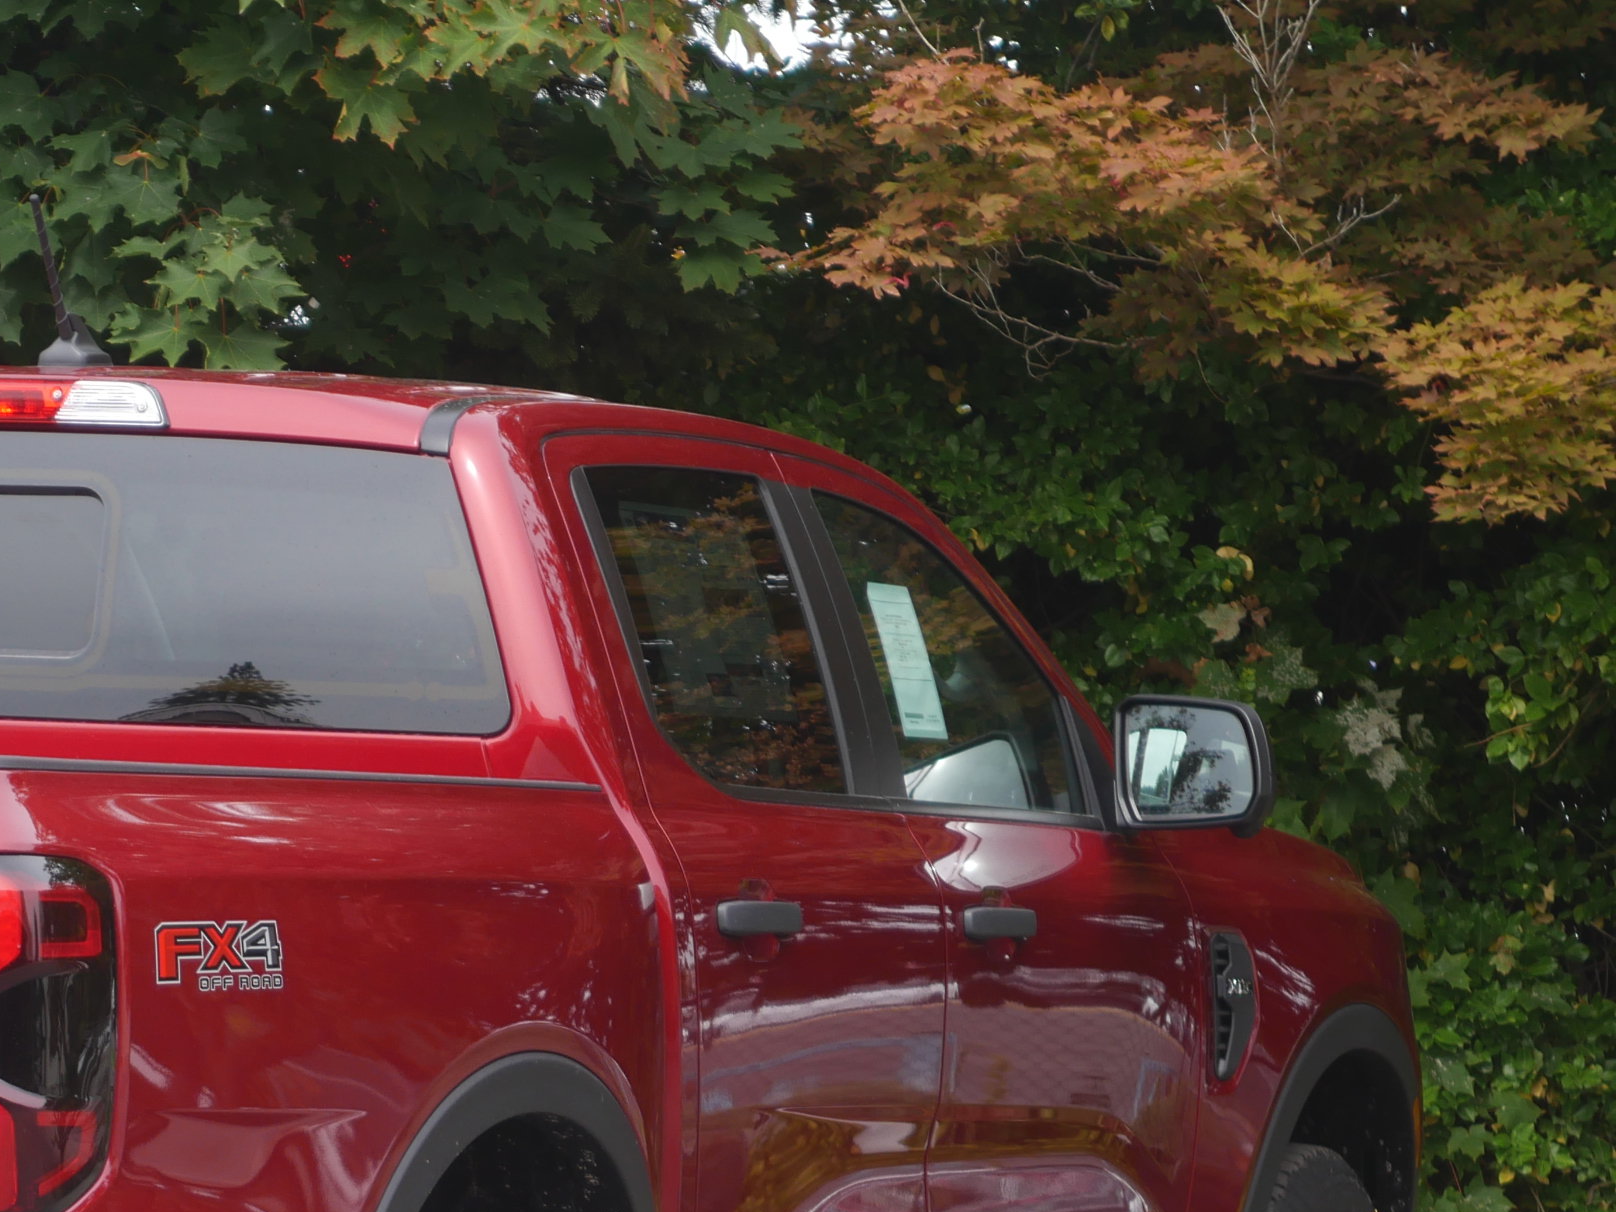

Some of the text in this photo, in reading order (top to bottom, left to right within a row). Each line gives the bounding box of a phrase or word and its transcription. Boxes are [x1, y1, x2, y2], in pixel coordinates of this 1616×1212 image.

[154, 919, 282, 984] FX4
[199, 974, 283, 992] OFF ROAD
